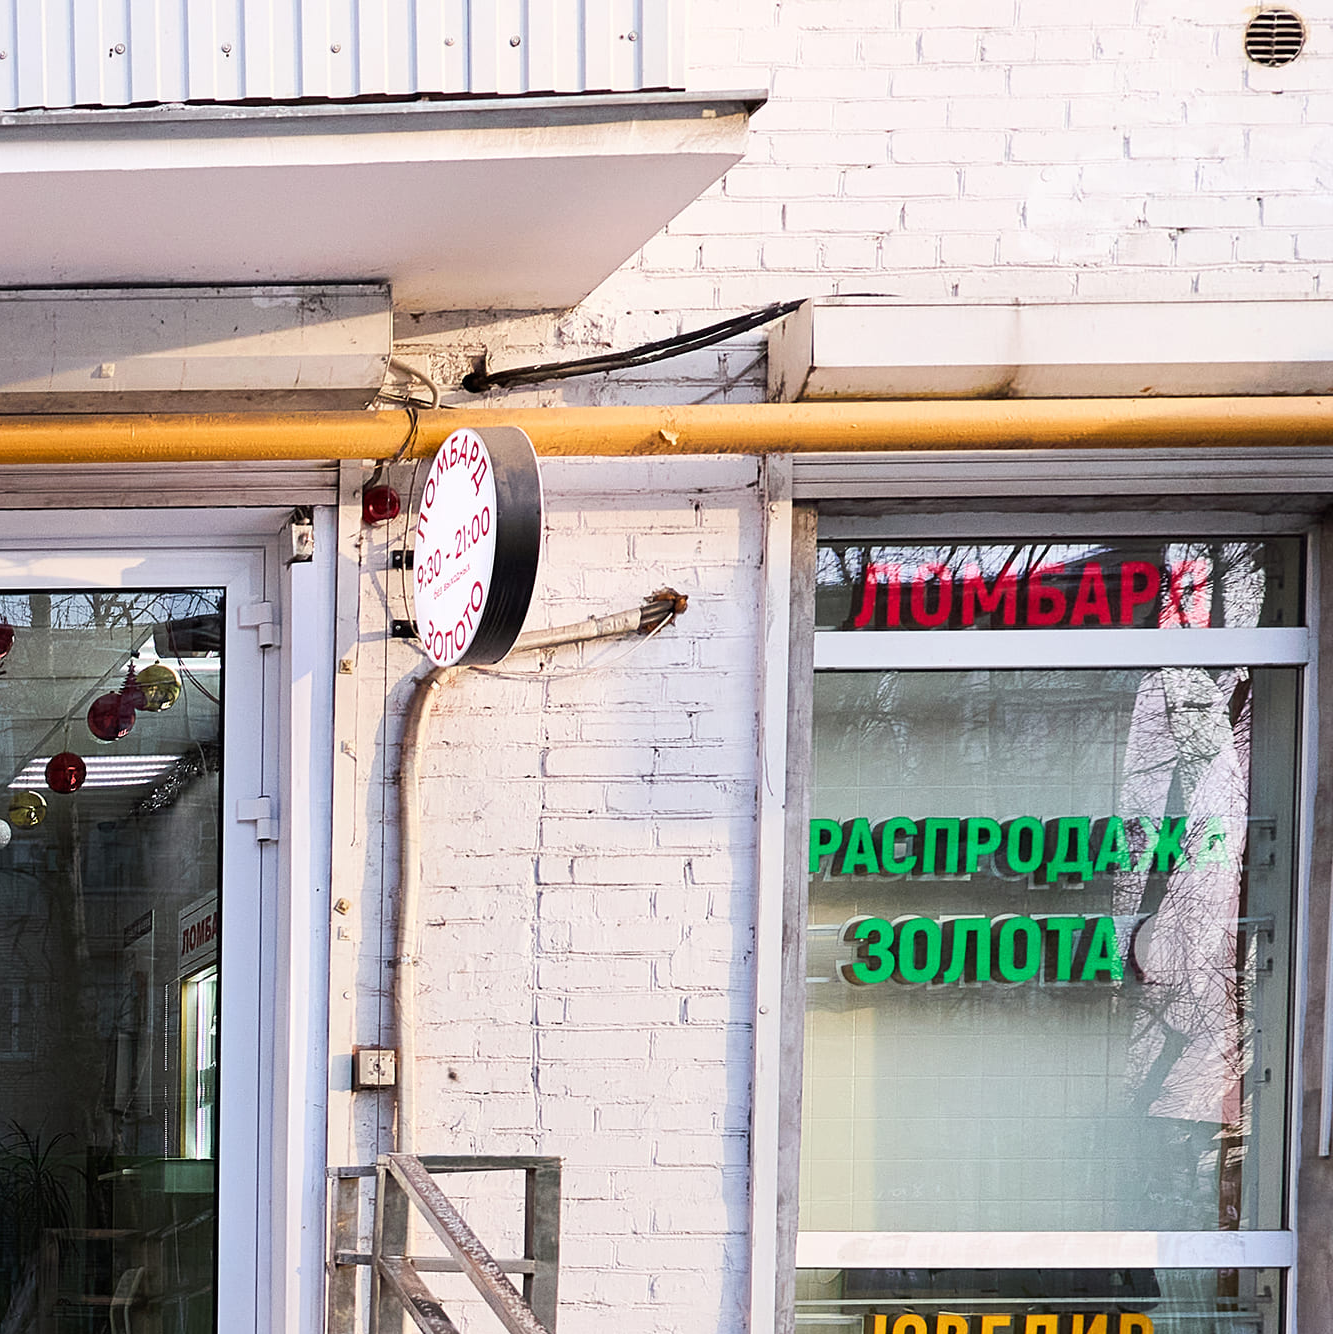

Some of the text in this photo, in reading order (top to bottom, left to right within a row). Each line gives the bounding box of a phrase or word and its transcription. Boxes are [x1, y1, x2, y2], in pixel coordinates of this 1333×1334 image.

[418, 435, 488, 543] ЛОМБАРД
[417, 549, 442, 593] 9:30
[455, 506, 490, 560] 21:00
[425, 580, 483, 662] ЗОЛОТО
[854, 560, 1212, 629] ЛОМБАРД
[809, 816, 1231, 882] РАСПРОДАЖА
[853, 916, 1124, 984] ЗОЛОТА
